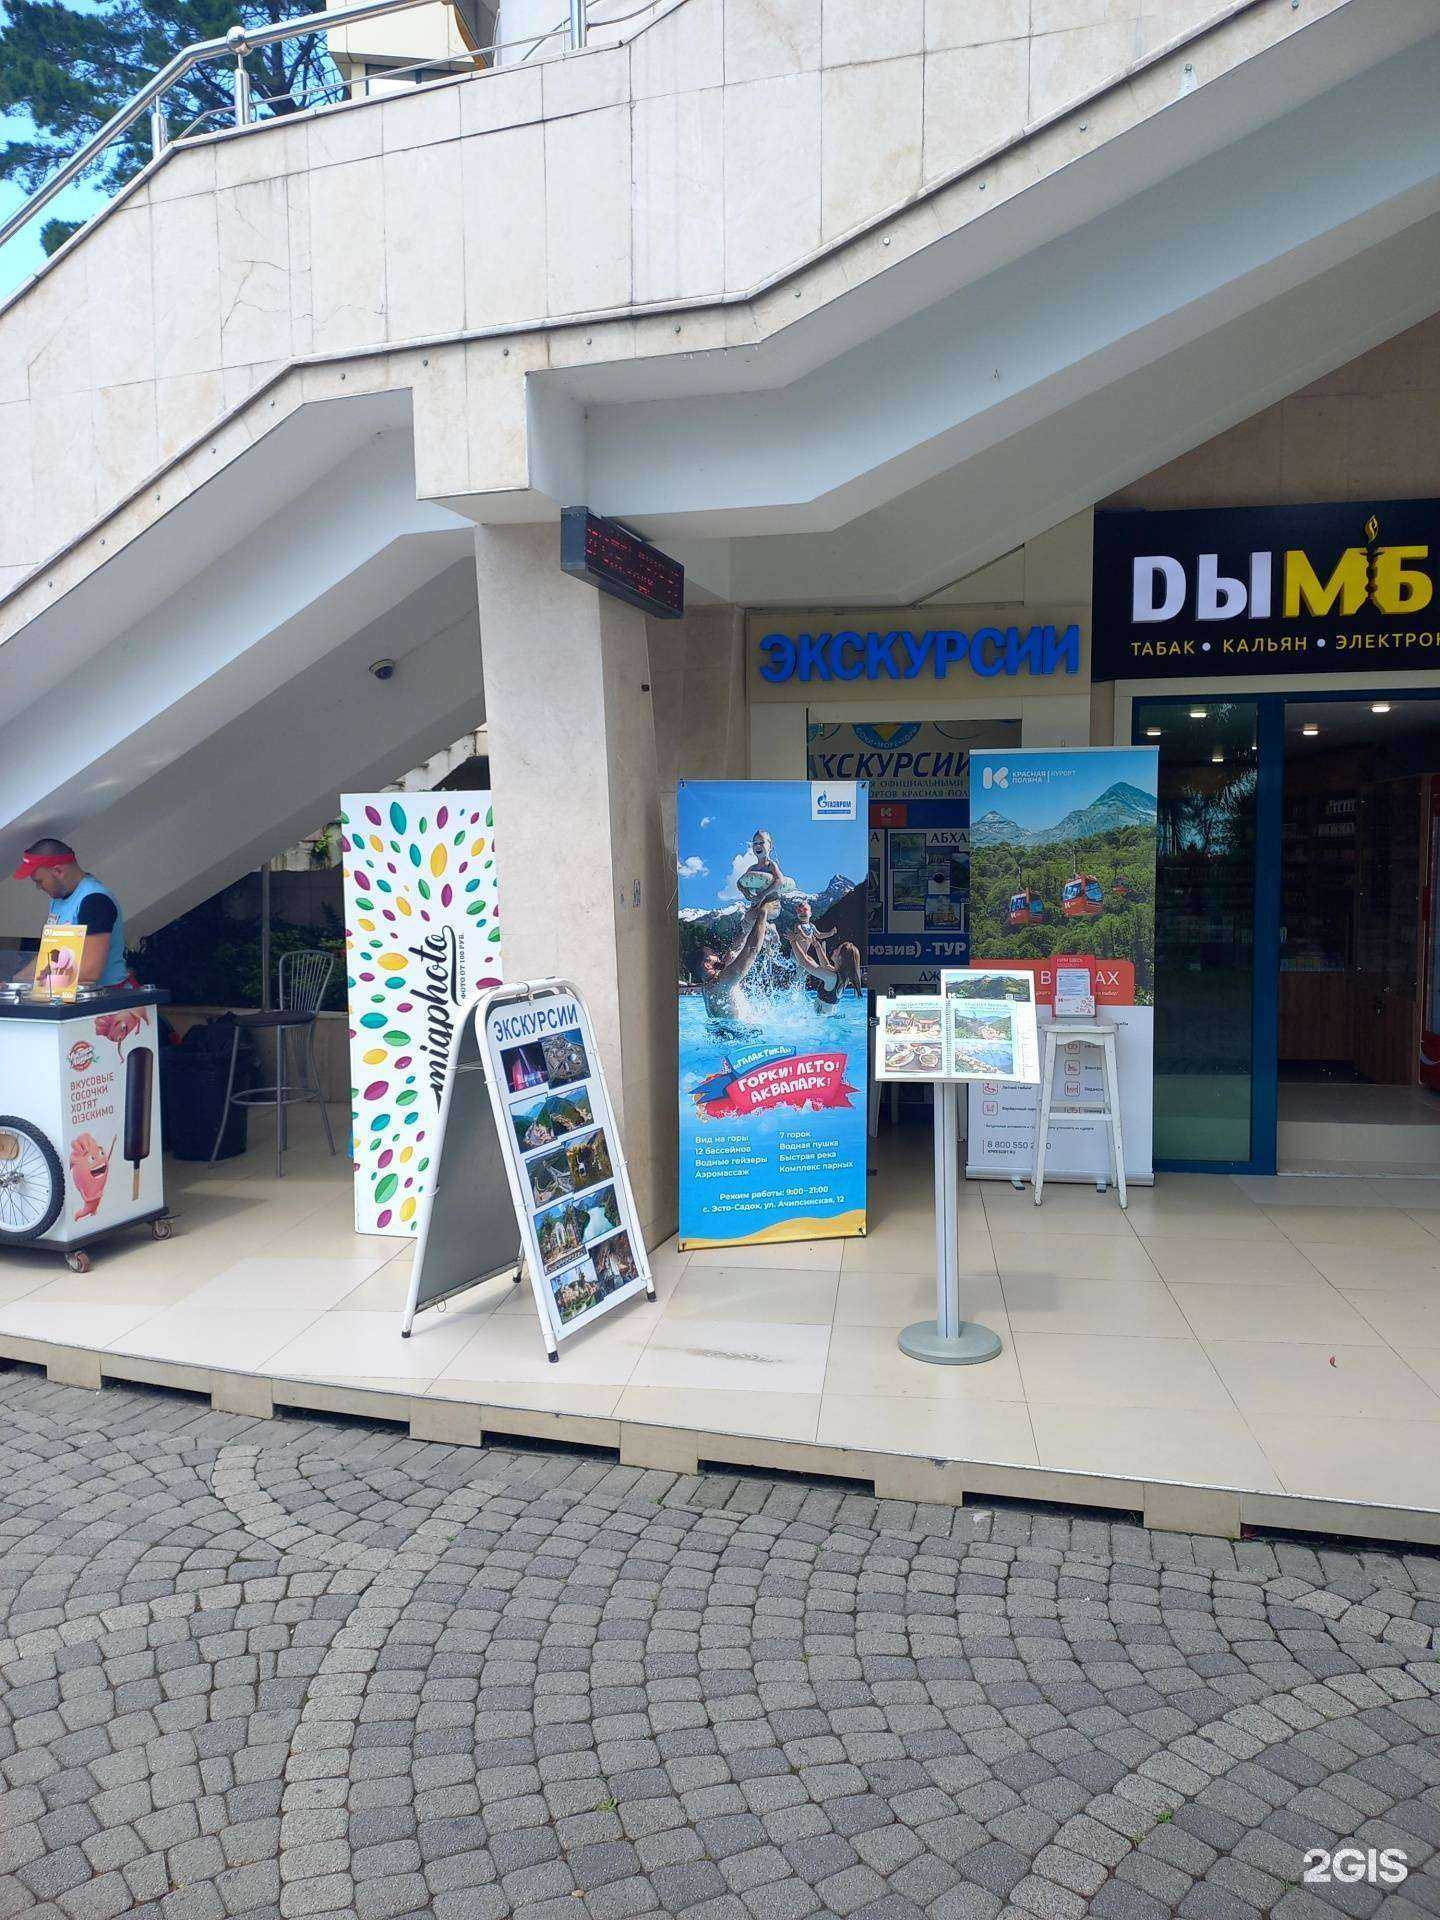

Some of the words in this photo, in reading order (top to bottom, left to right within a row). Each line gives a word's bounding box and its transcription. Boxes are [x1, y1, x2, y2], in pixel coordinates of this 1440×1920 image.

[759, 625, 1080, 683] ЭКСКУРСИИ
[1131, 640, 1195, 657] ТАБАК
[1223, 637, 1307, 653] КАЛЬЯН
[812, 752, 970, 778] КСКУРСИИ
[902, 790, 943, 798] КРАСНАЯ
[931, 832, 970, 844] АБХА
[869, 941, 921, 958] юзив)
[493, 1003, 578, 1042] ЭКСКУРСИИ
[70, 1072, 114, 1091] ВКУСОВЫЕ
[738, 1065, 793, 1093] ГОРКИ!
[796, 1059, 840, 1075] ЛЕТО!
[70, 1085, 109, 1102] СОСОЧКИ
[750, 1076, 832, 1104] АКВАПАРК!
[71, 1099, 97, 1113] ХОТЯТ
[695, 1136, 713, 1144] Вид
[727, 1135, 749, 1143] горы
[786, 1130, 811, 1139] горок
[705, 1145, 752, 1155] бассейнов
[779, 1142, 811, 1151] Водная
[812, 1140, 839, 1149] пушка
[695, 1158, 730, 1167] Водные
[731, 1156, 768, 1165] гейзеры
[779, 1153, 815, 1162] Быстрая
[816, 1151, 837, 1160] река
[694, 1169, 750, 1179] Аэромассаж
[779, 1164, 821, 1174] Комплекс
[822, 1160, 854, 1170] парных
[719, 1192, 750, 1201] Режим
[751, 1189, 785, 1200] работы:
